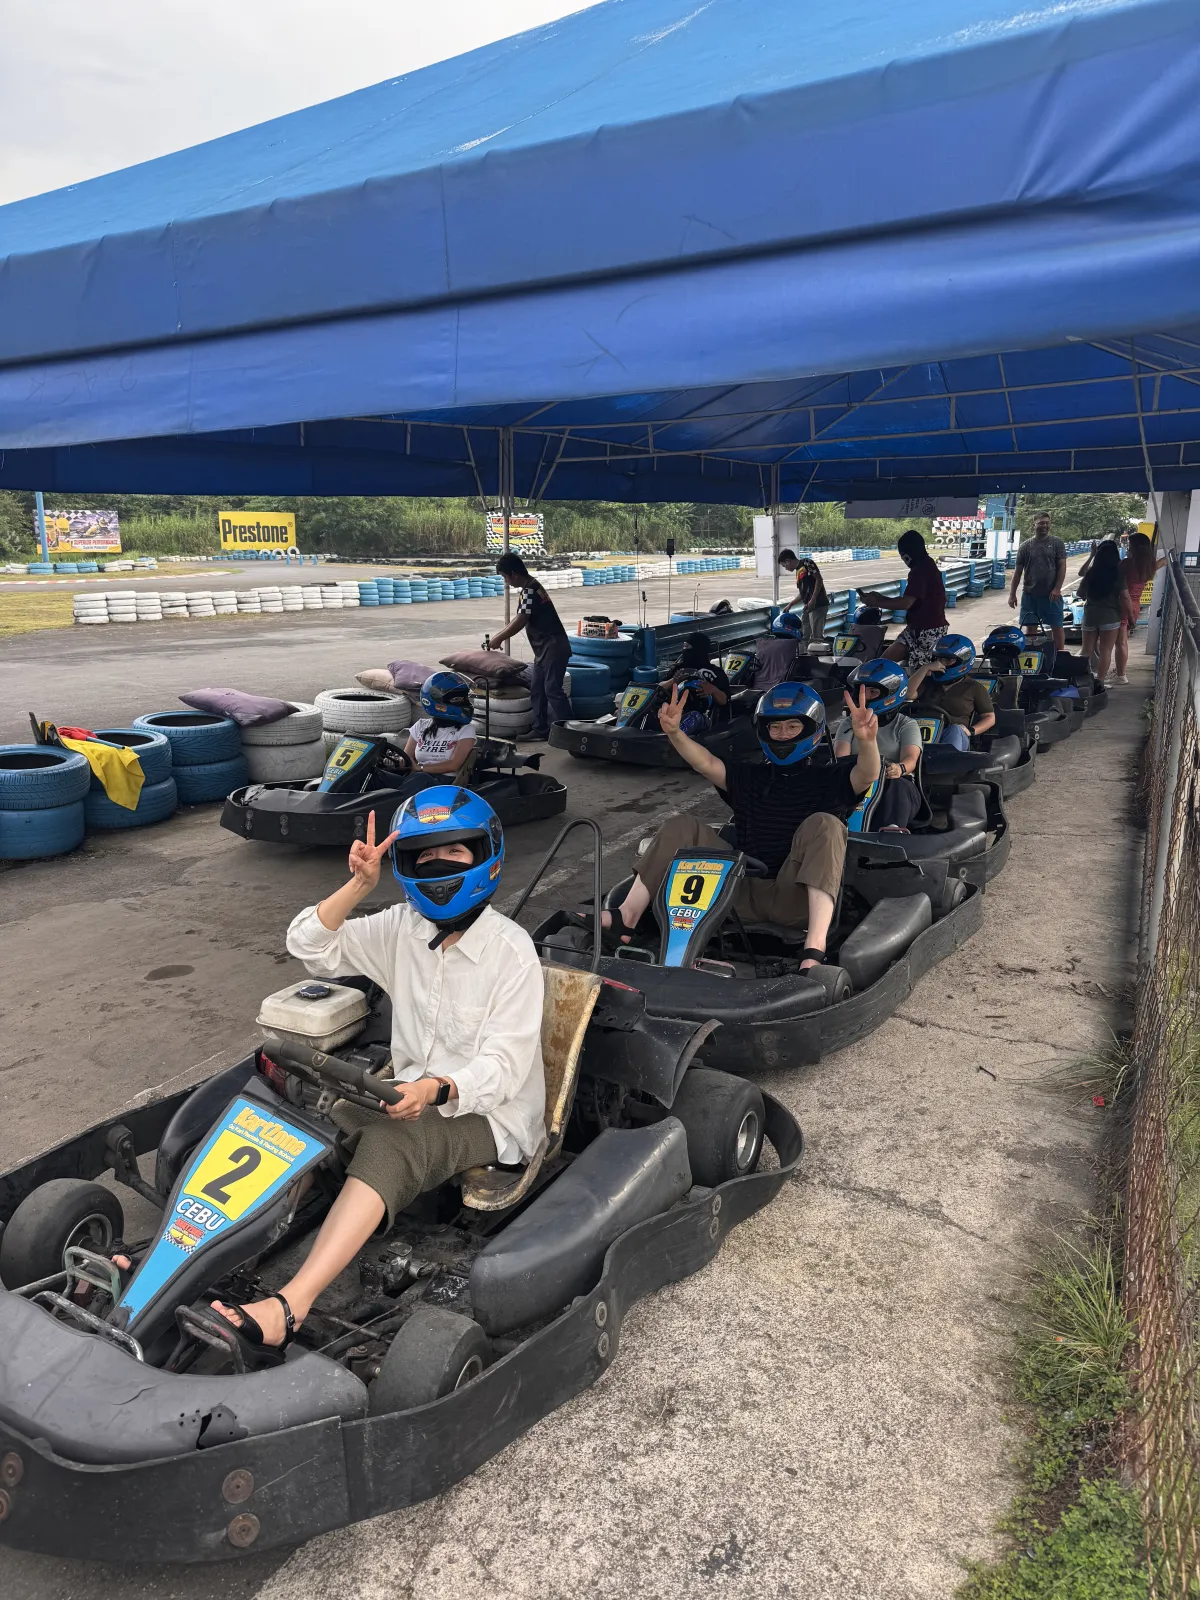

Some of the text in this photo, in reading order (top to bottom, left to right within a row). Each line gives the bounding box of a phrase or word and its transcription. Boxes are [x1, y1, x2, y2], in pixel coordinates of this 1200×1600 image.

[728, 660, 742, 671] 12
[1024, 658, 1033, 668] 4
[627, 694, 640, 707] 8
[335, 749, 354, 767] 5
[680, 875, 705, 905] 9
[669, 907, 702, 918] CEBU
[233, 1106, 307, 1156] KartZone
[200, 1145, 262, 1205] 2
[176, 1198, 227, 1231] CEBU
